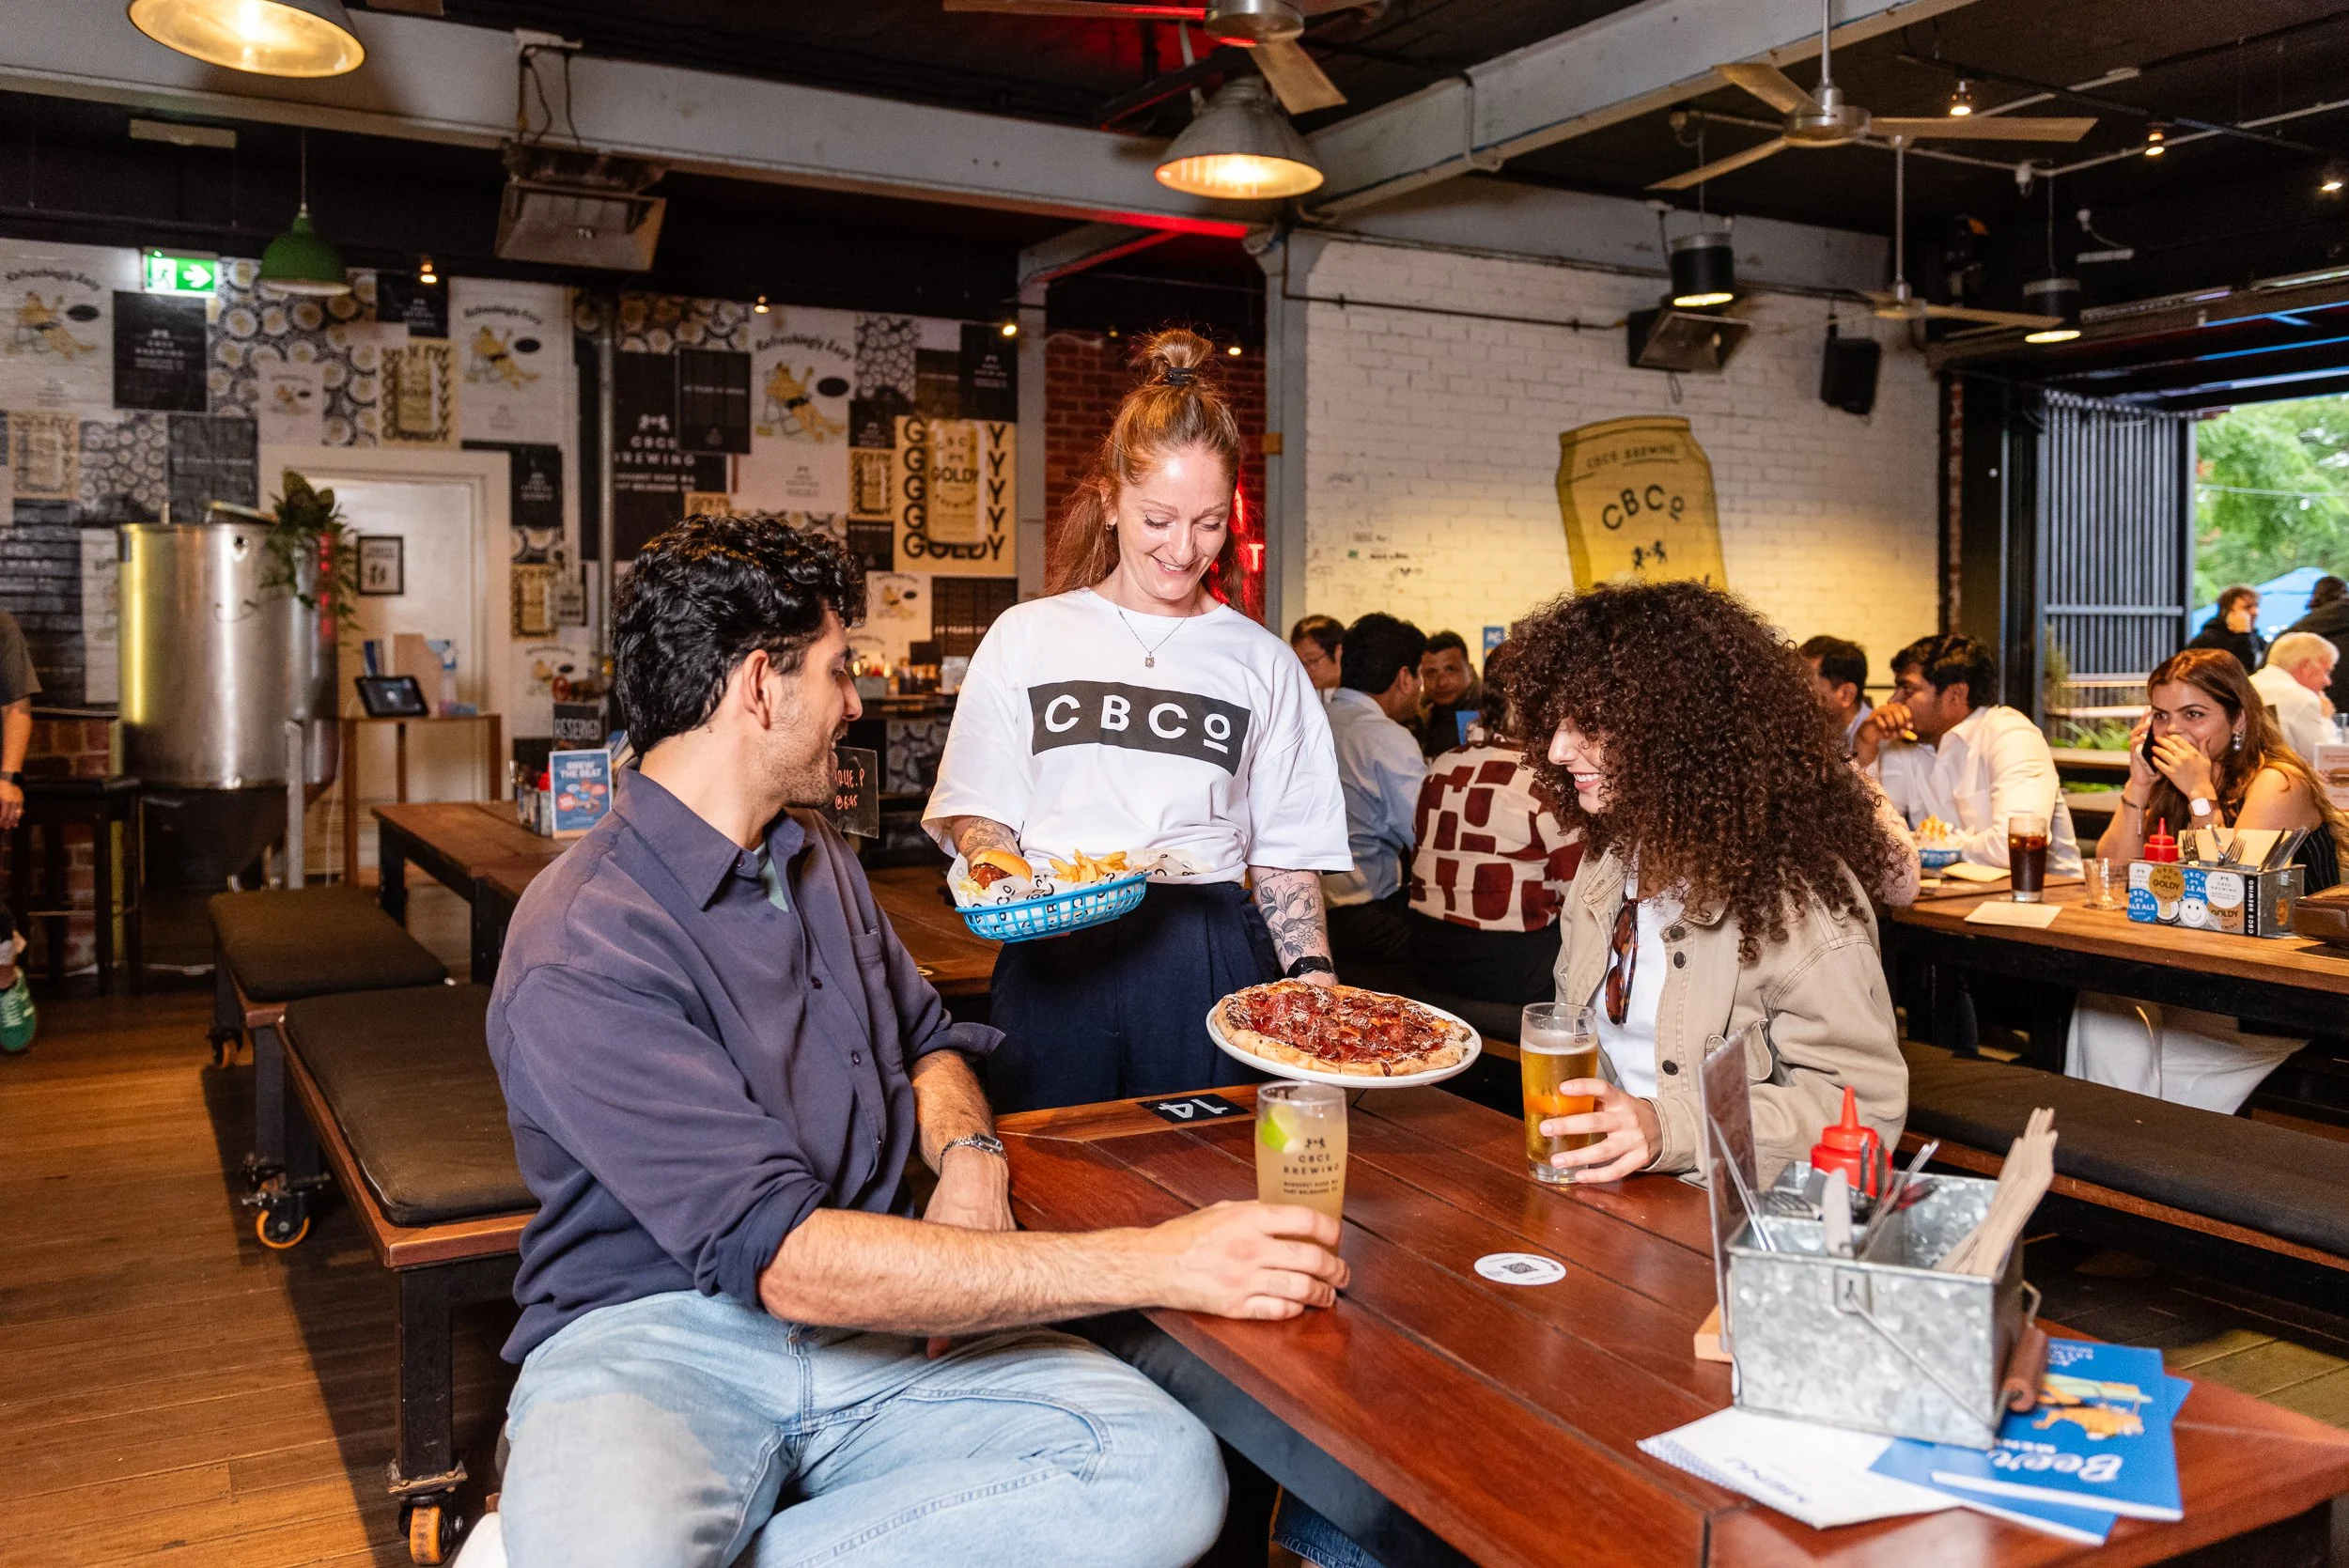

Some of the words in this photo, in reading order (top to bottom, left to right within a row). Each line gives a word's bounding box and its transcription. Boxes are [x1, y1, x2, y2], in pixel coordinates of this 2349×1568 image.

[2153, 878, 2181, 891] GOLDY
[2247, 879, 2255, 912] BREWING
[2142, 903, 2156, 911] ALE
[2210, 909, 2239, 918] GOLDY
[1157, 1097, 1230, 1120] 14
[1283, 1163, 1340, 1175] BREWING
[1987, 1450, 2124, 1483] Beer
